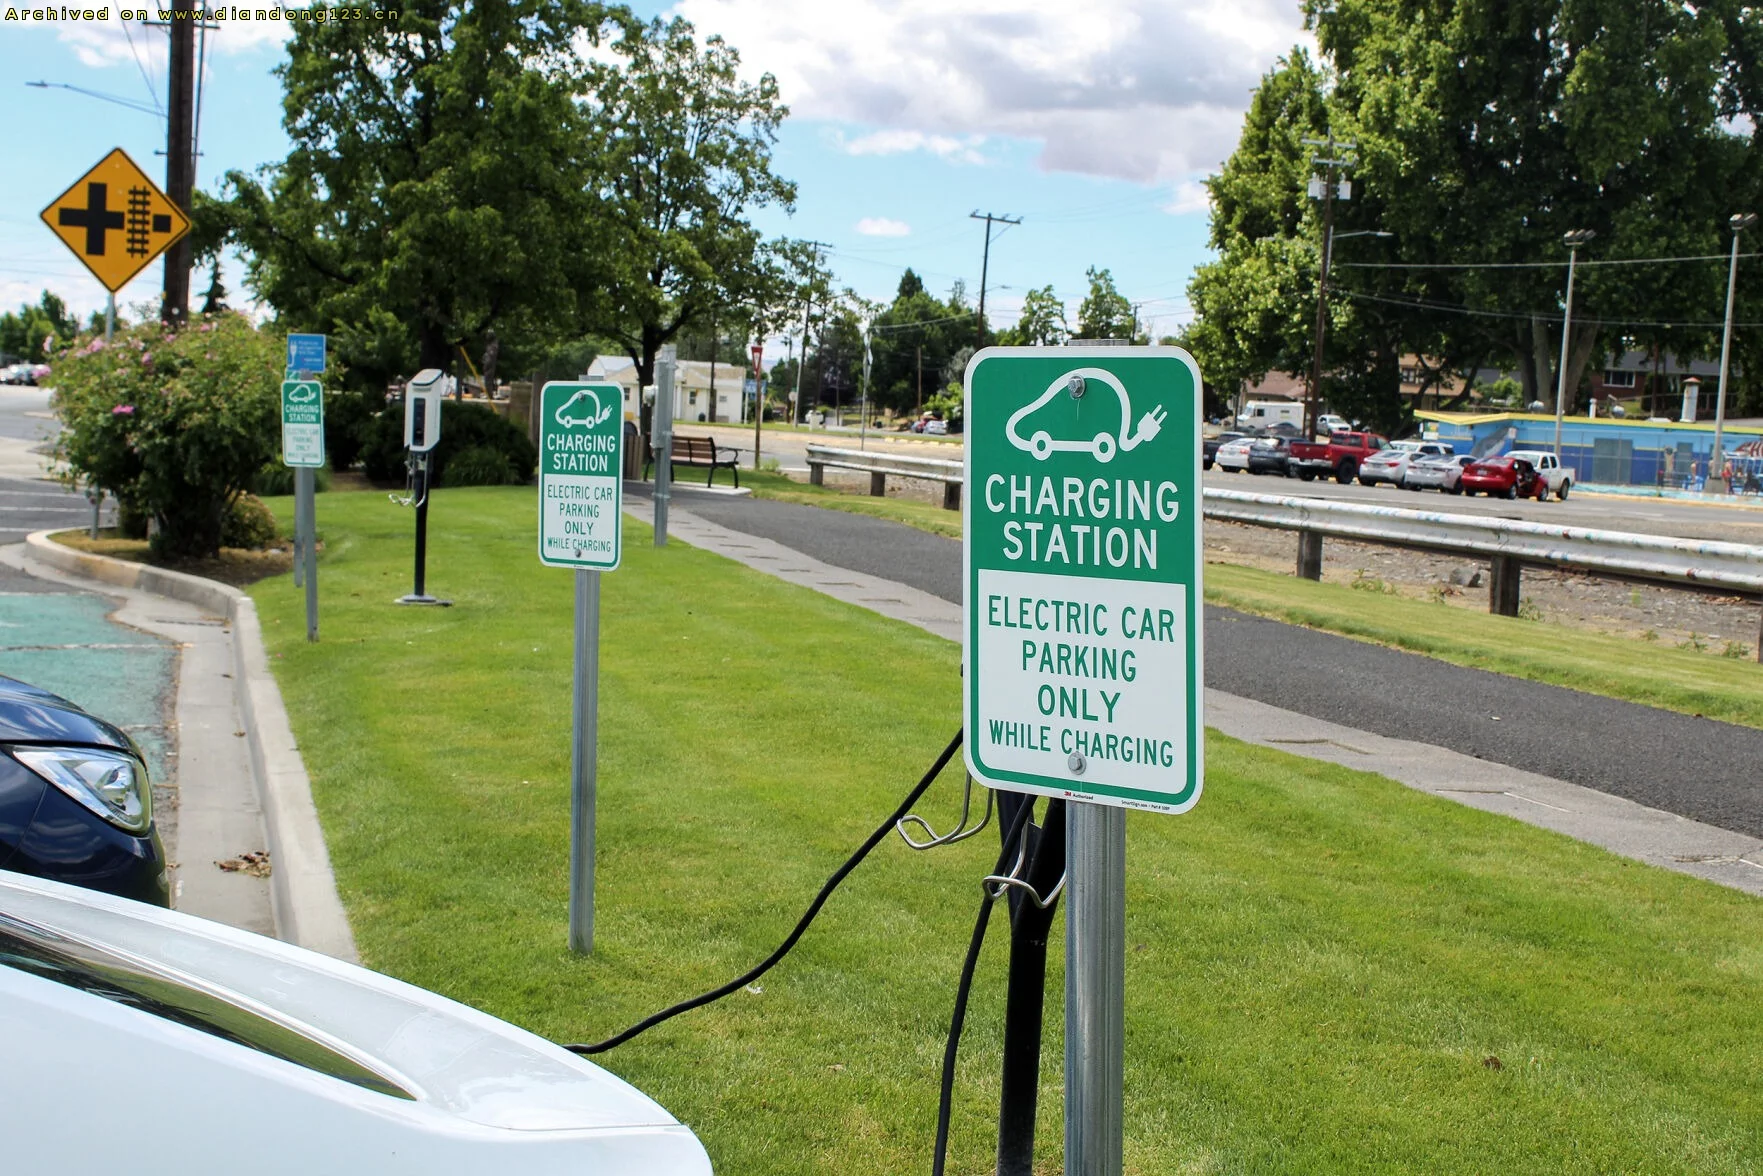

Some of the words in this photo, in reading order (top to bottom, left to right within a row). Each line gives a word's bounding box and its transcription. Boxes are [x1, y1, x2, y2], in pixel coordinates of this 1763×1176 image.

[285, 404, 319, 413] CHARGING
[288, 413, 316, 422] STATION
[547, 434, 616, 452] CHARGING
[553, 453, 608, 472] STATION
[547, 484, 590, 500] ELECTRIC
[594, 487, 612, 501] CAR
[985, 474, 1179, 522] CHARGING
[559, 502, 600, 518] PARKING
[564, 521, 594, 536] ONLY
[547, 536, 570, 550] WHILE
[572, 538, 611, 552] CHARGING
[1003, 521, 1157, 569] STATION
[988, 595, 1108, 636] ELECTRIC
[1121, 606, 1175, 643] CAR
[1022, 640, 1136, 683] PARKING
[1037, 684, 1121, 723] ONLY
[989, 719, 1051, 752] WHILE
[1061, 728, 1173, 768] CHARGING
